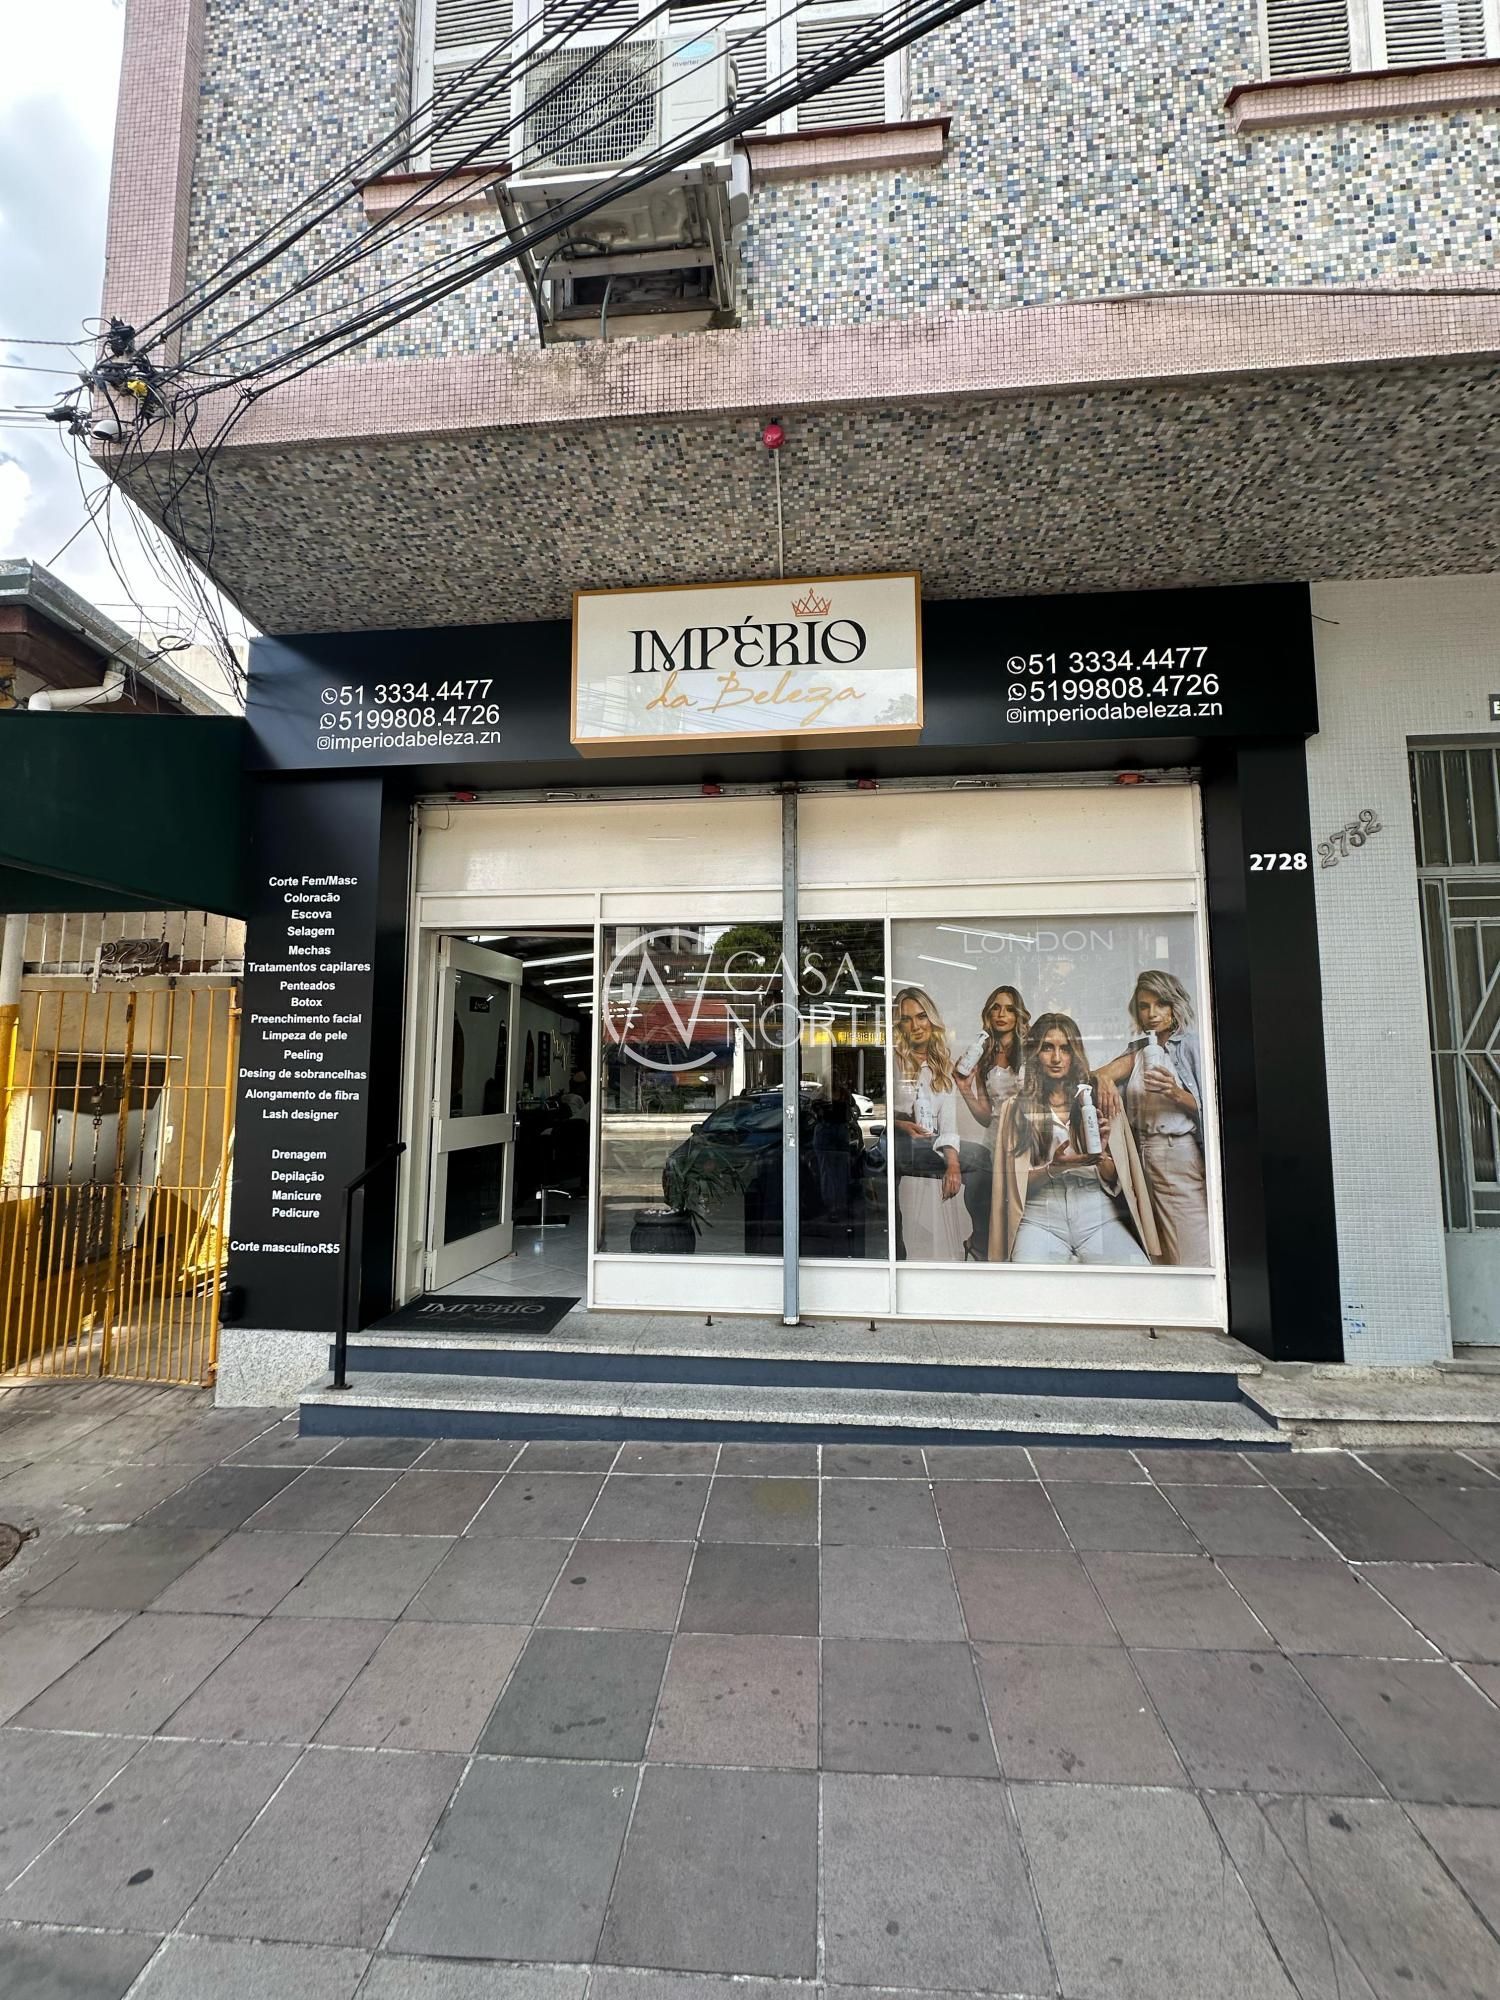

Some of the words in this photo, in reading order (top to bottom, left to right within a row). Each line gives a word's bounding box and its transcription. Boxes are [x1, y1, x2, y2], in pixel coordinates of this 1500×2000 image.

[628, 615, 867, 673] IMPÉRIO
[1029, 653, 1056, 675] 51
[1069, 646, 1208, 674] 3334.4477
[339, 685, 364, 706] 51
[374, 679, 493, 704] 3334.4477
[1029, 673, 1219, 702] 5199808.4726
[697, 670, 866, 726] Beleza
[338, 705, 500, 731] 5199808.4726
[1022, 701, 1223, 726] imperiodabeleza.zn
[330, 730, 501, 752] imperiodabeleza.zn
[1317, 808, 1383, 869] 2732
[1250, 853, 1307, 871] 2728
[268, 876, 299, 887] Corte
[301, 875, 358, 886] Fem/Masc
[291, 909, 332, 920] Escova
[286, 926, 335, 939] Selagem
[963, 930, 1113, 953] LONDON
[288, 945, 332, 956] Mechas
[247, 962, 317, 973] Tratamentos
[319, 961, 371, 974] capilares
[279, 980, 336, 991] Penteados
[290, 997, 323, 1007] Botox
[250, 1013, 331, 1024] Preenchimento
[332, 1013, 362, 1024] facial
[262, 1031, 307, 1042] Limpeza
[308, 1030, 323, 1041] de
[324, 1031, 348, 1042] pele
[283, 1049, 324, 1062] Peeling
[239, 1068, 277, 1080] Desing
[278, 1068, 293, 1079] de
[293, 1069, 368, 1080] sobrancelhas
[244, 1088, 317, 1101] Alongamento
[318, 1089, 333, 1100] de
[334, 1090, 360, 1101] fibra
[262, 1109, 289, 1120] Lash
[290, 1110, 340, 1121] designer
[271, 1149, 327, 1162] Drenagem
[271, 1170, 325, 1184] Depilação
[271, 1190, 322, 1201] Manicure
[271, 1207, 320, 1219] Pedicure
[230, 1240, 260, 1252] Corte
[418, 1302, 546, 1314] IMPÉRIO
